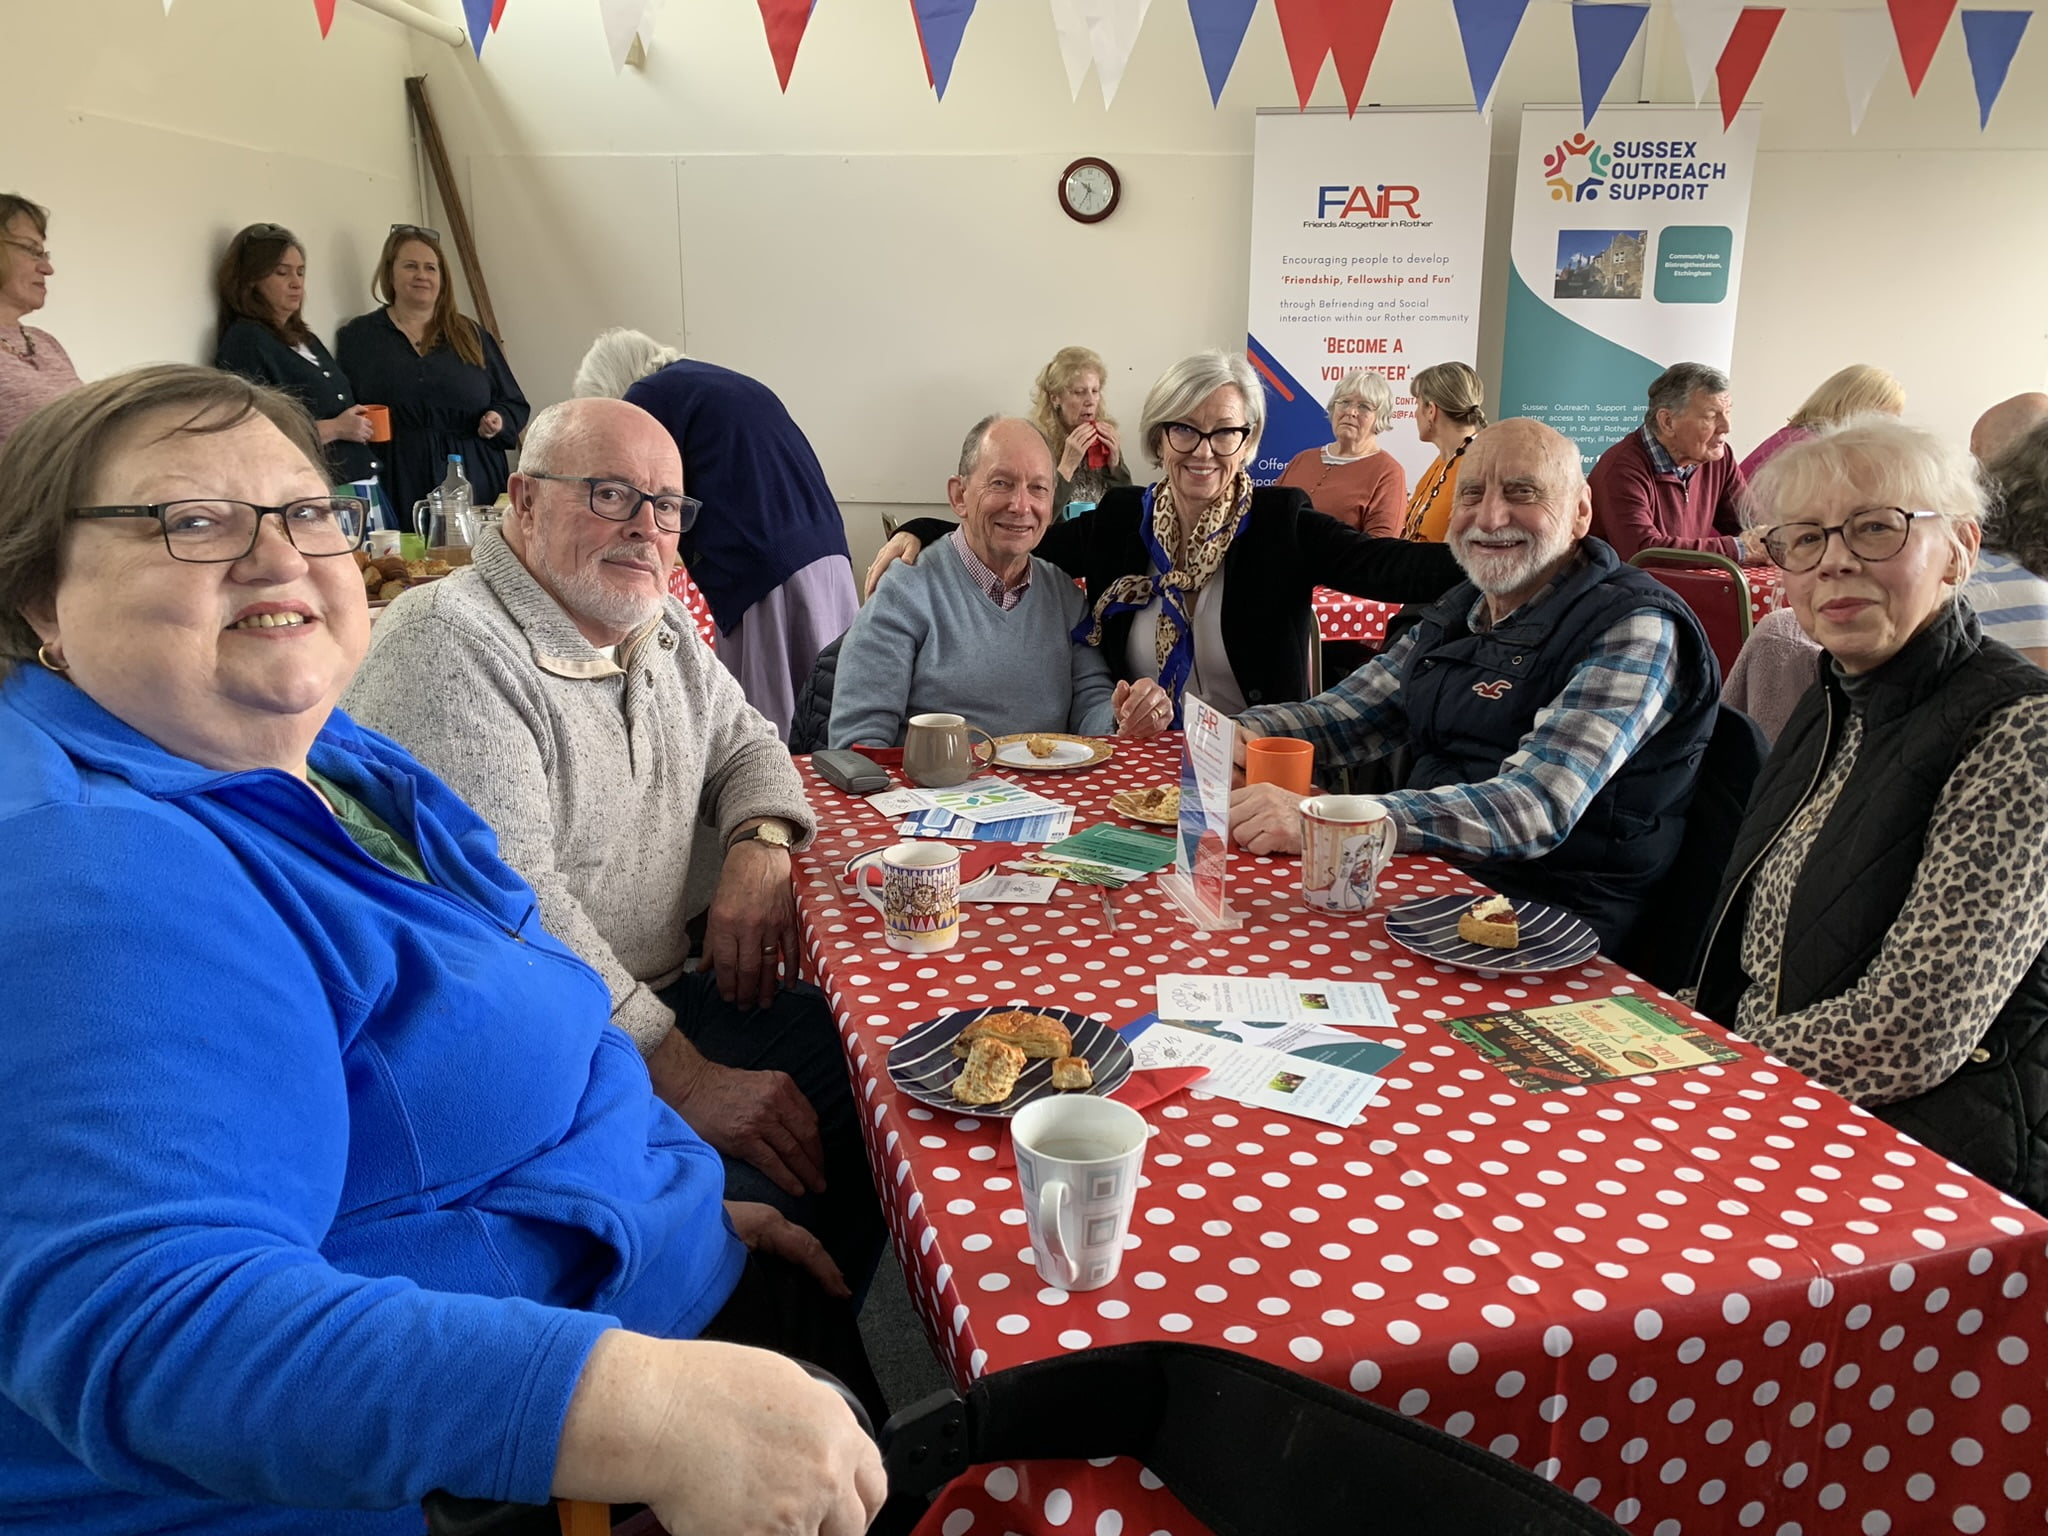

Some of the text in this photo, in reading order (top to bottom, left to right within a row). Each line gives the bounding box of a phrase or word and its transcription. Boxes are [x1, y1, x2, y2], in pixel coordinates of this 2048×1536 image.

[1612, 141, 1697, 158] SUSSEX
[1611, 162, 1726, 180] OUTREACH
[1609, 183, 1709, 200] SUPPORT
[1303, 220, 1337, 228] Friends
[1339, 220, 1389, 230] Altogether
[1399, 220, 1433, 228] Rother
[1282, 253, 1450, 267] Encouraging people to develop
[1668, 253, 1706, 261] Community
[1347, 274, 1404, 286] Fellowship
[1407, 274, 1429, 284] and
[1280, 299, 1429, 311] through Befriending and Social
[1279, 314, 1332, 323] interaction
[1335, 313, 1363, 323] within
[1384, 312, 1415, 322] Rother
[1418, 313, 1469, 324] community
[1393, 338, 1403, 353] A
[1596, 404, 1626, 413] Support
[1622, 414, 1638, 422] and
[1495, 1016, 1592, 1078] CELEBRATION!
